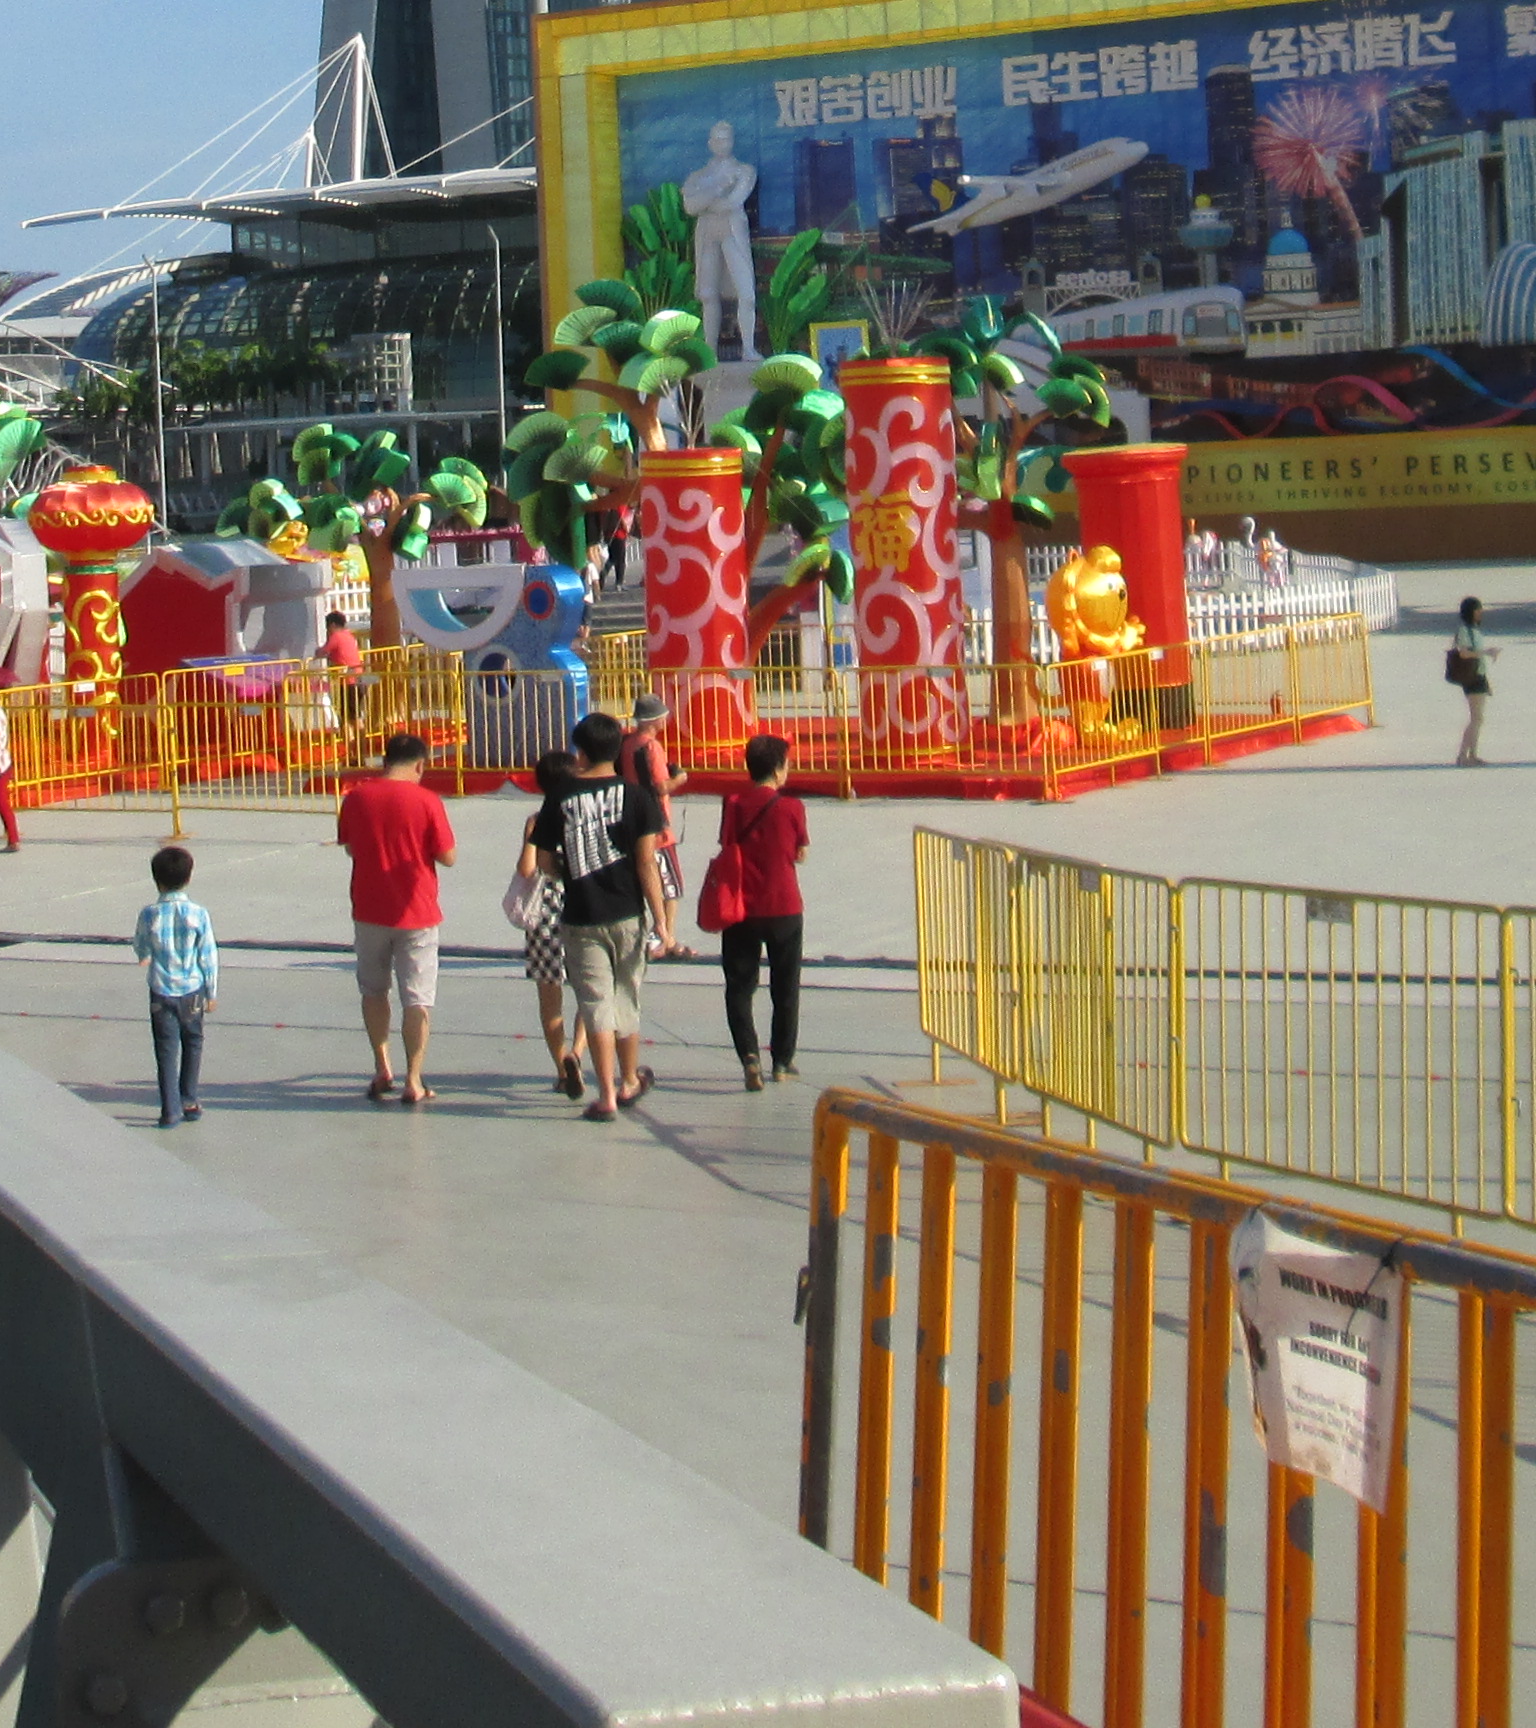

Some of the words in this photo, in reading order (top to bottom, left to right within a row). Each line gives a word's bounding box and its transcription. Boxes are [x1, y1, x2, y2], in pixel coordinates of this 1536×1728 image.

[775, 65, 957, 127] 艰苦创业
[1000, 40, 1199, 107] 民生跨越
[1249, 10, 1458, 82] 经济腾飞
[852, 488, 914, 573] 福
[1275, 485, 1367, 502] THRIVING
